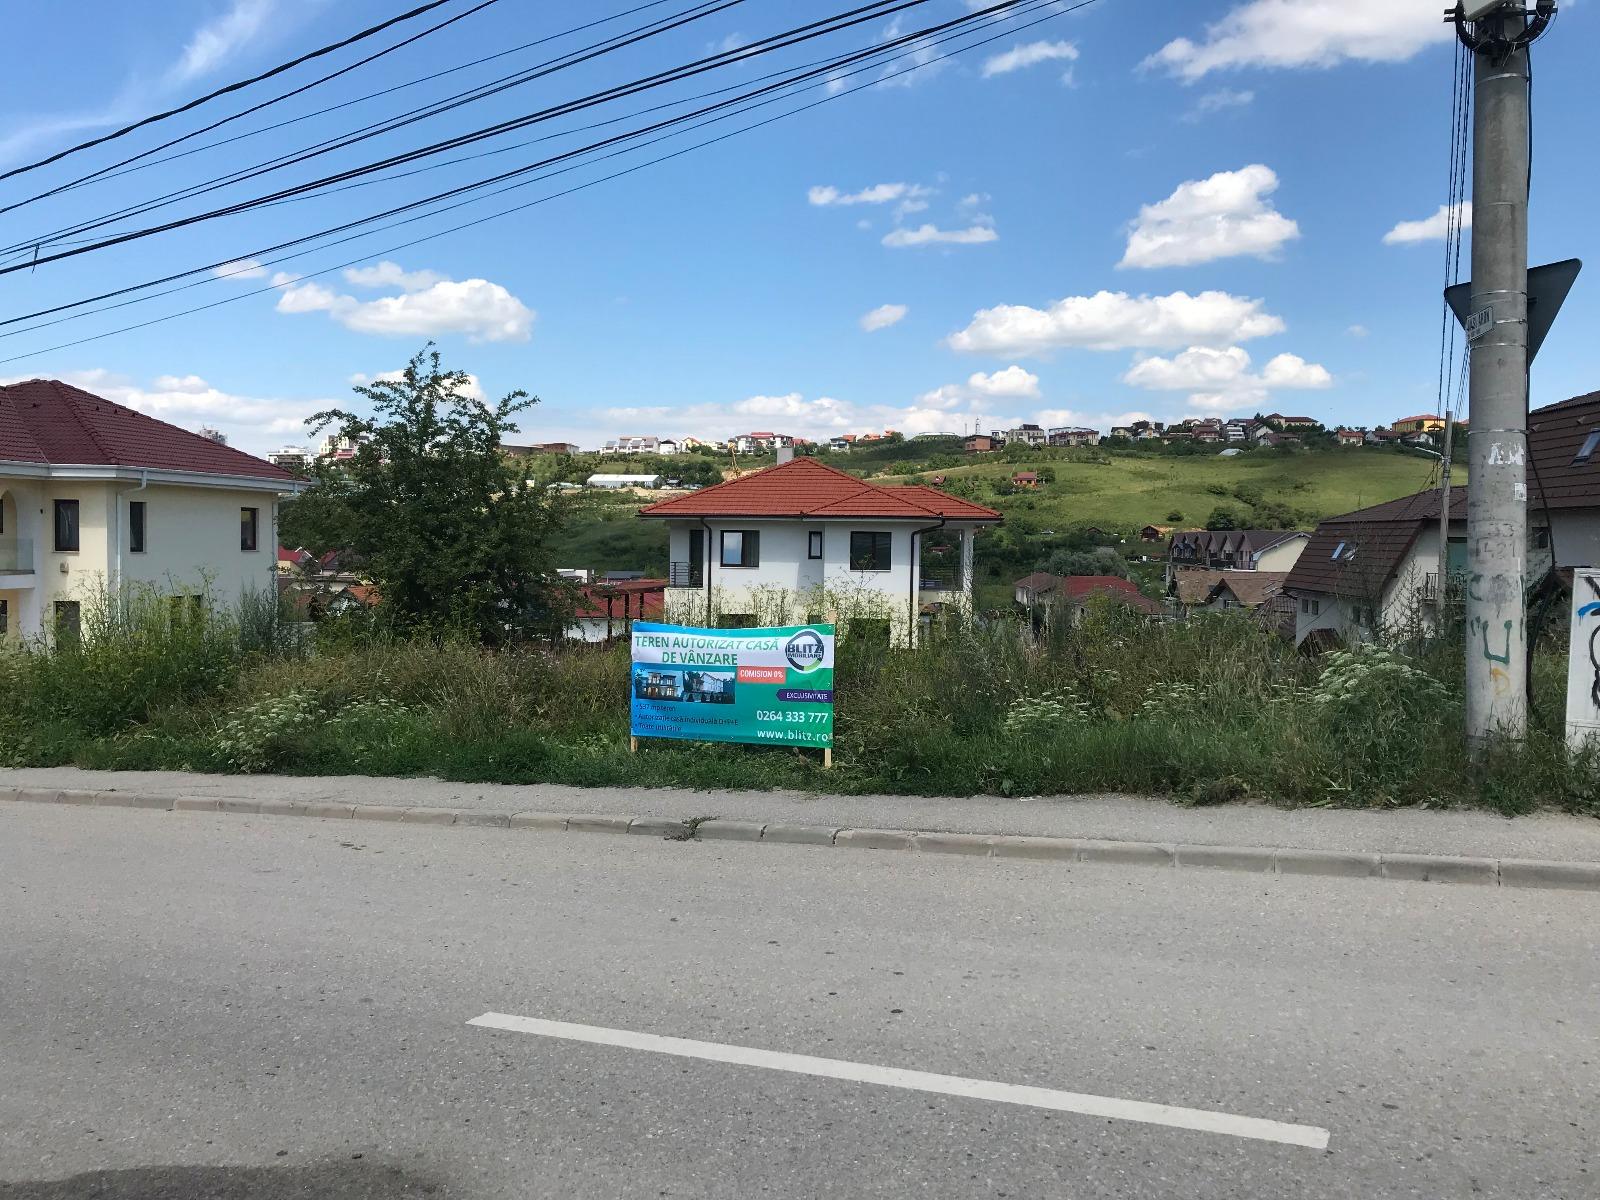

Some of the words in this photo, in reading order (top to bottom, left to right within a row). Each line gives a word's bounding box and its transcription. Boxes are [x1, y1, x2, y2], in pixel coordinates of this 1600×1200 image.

[635, 636, 669, 648] TEREN
[673, 637, 744, 650] AUTORIZAT
[746, 638, 779, 650] CASĂ
[787, 644, 822, 654] BLITZ
[662, 652, 676, 664] DE
[680, 650, 738, 666] VÂNZARE
[740, 670, 772, 678] COMISION
[756, 710, 783, 722] 0264
[786, 712, 805, 722] 333
[808, 712, 828, 724] 777
[757, 730, 828, 742] www.blitz.ro
